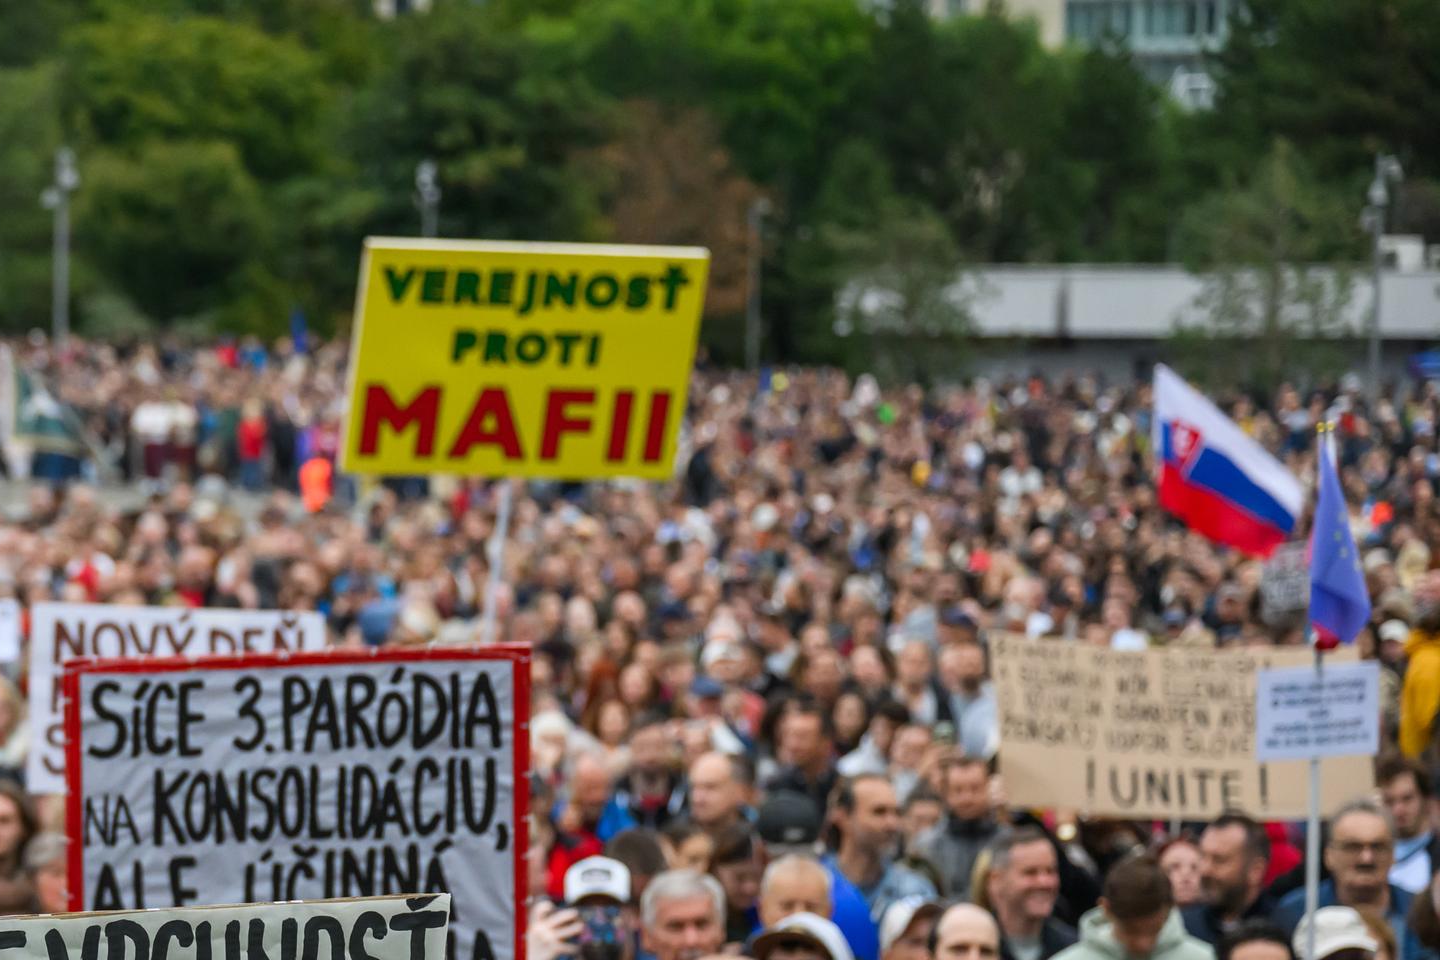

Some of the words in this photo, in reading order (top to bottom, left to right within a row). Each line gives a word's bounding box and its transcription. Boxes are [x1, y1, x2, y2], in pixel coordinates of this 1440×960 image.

[452, 329, 602, 365] PROTI
[357, 383, 671, 463] MAFII
[53, 614, 195, 663] NOVÝ
[85, 794, 140, 846] NA
[154, 757, 510, 852] KONSOLIDÁCIU,
[1109, 767, 1241, 808] UNITE
